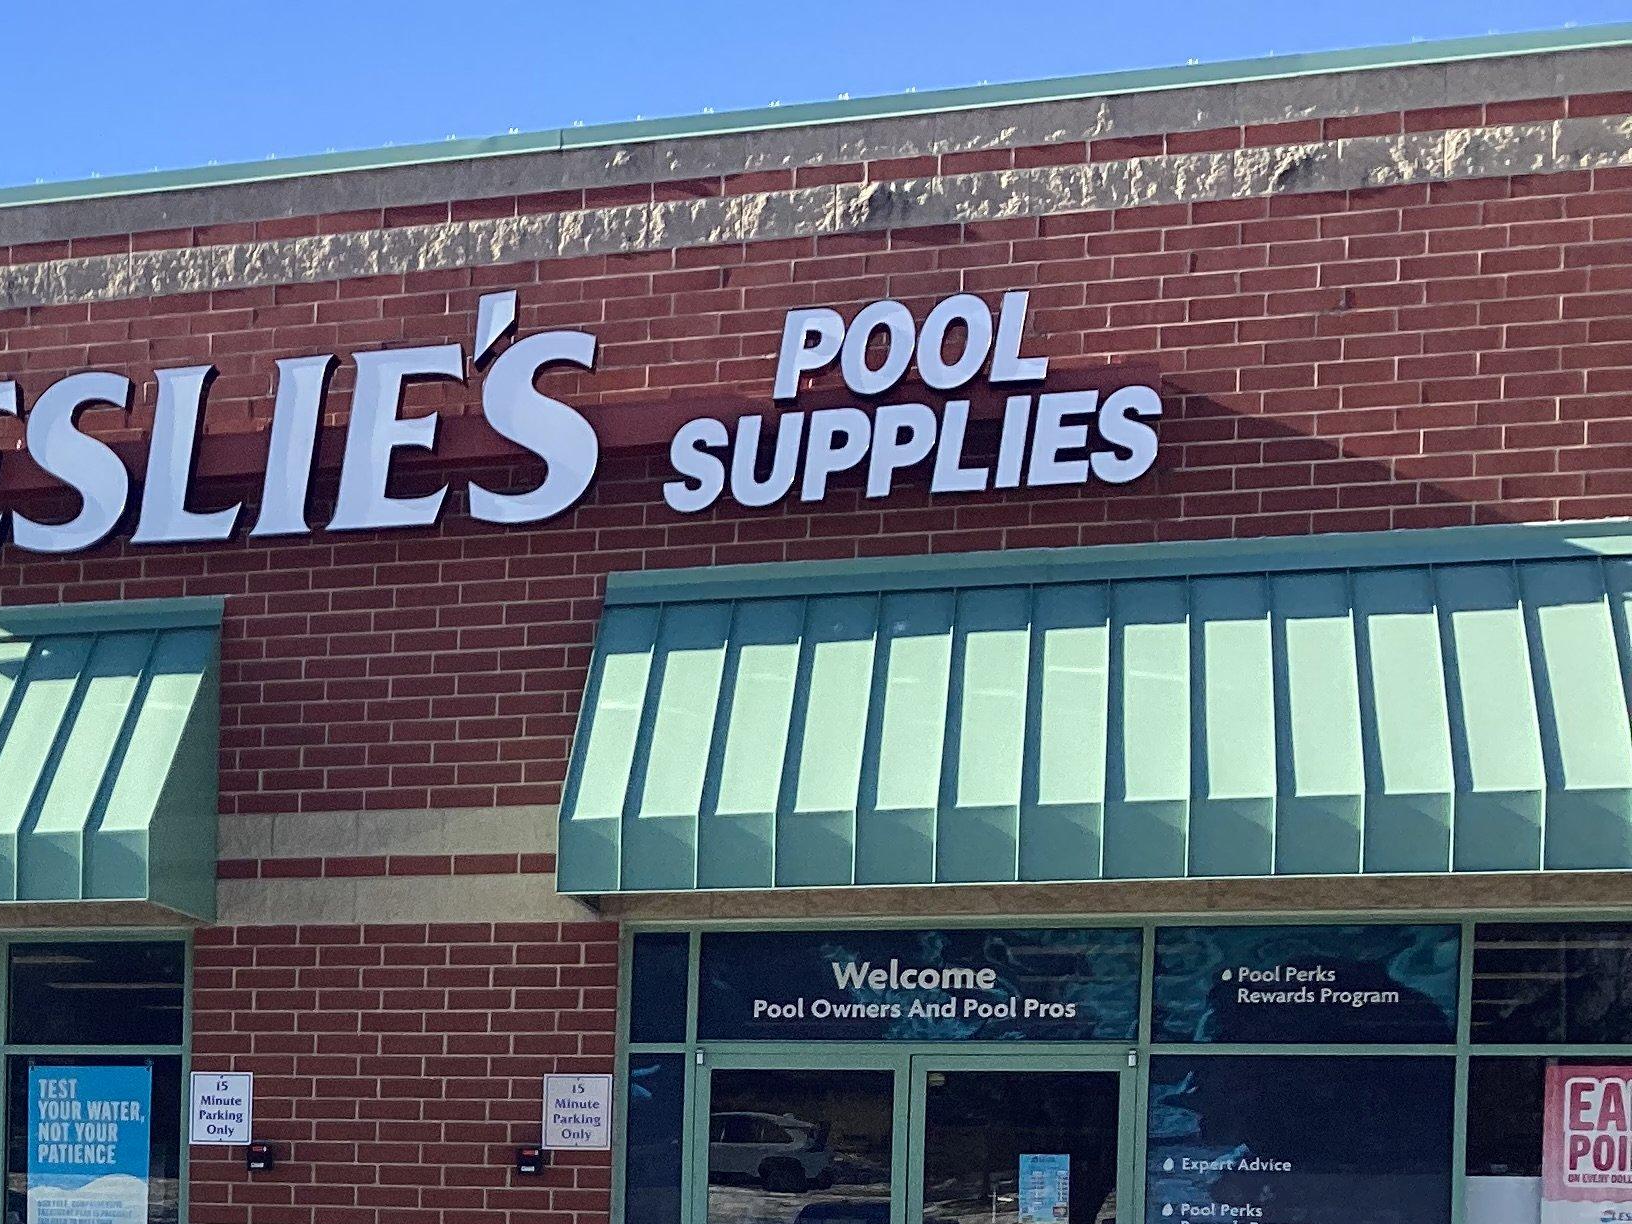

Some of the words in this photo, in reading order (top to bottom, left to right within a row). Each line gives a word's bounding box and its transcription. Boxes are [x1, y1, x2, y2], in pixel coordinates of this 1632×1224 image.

[772, 290, 1049, 400] POOL
[662, 385, 1163, 513] SUPPLIES
[831, 959, 997, 990] Welcome
[1238, 965, 1281, 983] Pool
[1285, 965, 1336, 983] Perks
[1237, 987, 1315, 1004] Rewards
[1320, 988, 1399, 1008] Program
[753, 998, 804, 1018] Pool
[811, 999, 901, 1018] Owners
[907, 997, 956, 1018] And
[964, 997, 1017, 1018] Pool
[1024, 998, 1076, 1018] Pros
[38, 1079, 77, 1099] TEST
[216, 1081, 229, 1092] 15
[571, 1083, 585, 1094] 15
[200, 1095, 243, 1106] Minute
[554, 1098, 601, 1109] Minute
[1569, 1082, 1632, 1132] EA
[37, 1100, 82, 1121] YOUR
[87, 1101, 146, 1124] WATER,
[199, 1109, 244, 1124] Parking
[553, 1113, 602, 1128] Parking
[38, 1122, 70, 1142] NOT
[74, 1122, 118, 1143] YOUR
[206, 1124, 235, 1137] Only
[561, 1128, 592, 1141] Only
[37, 1144, 117, 1165] PATIENCE
[1569, 1134, 1632, 1172] POI
[1181, 1157, 1233, 1174] Expert
[1237, 1156, 1292, 1172] Advice
[1180, 1203, 1216, 1217] Pool
[1220, 1203, 1263, 1217] Perks
